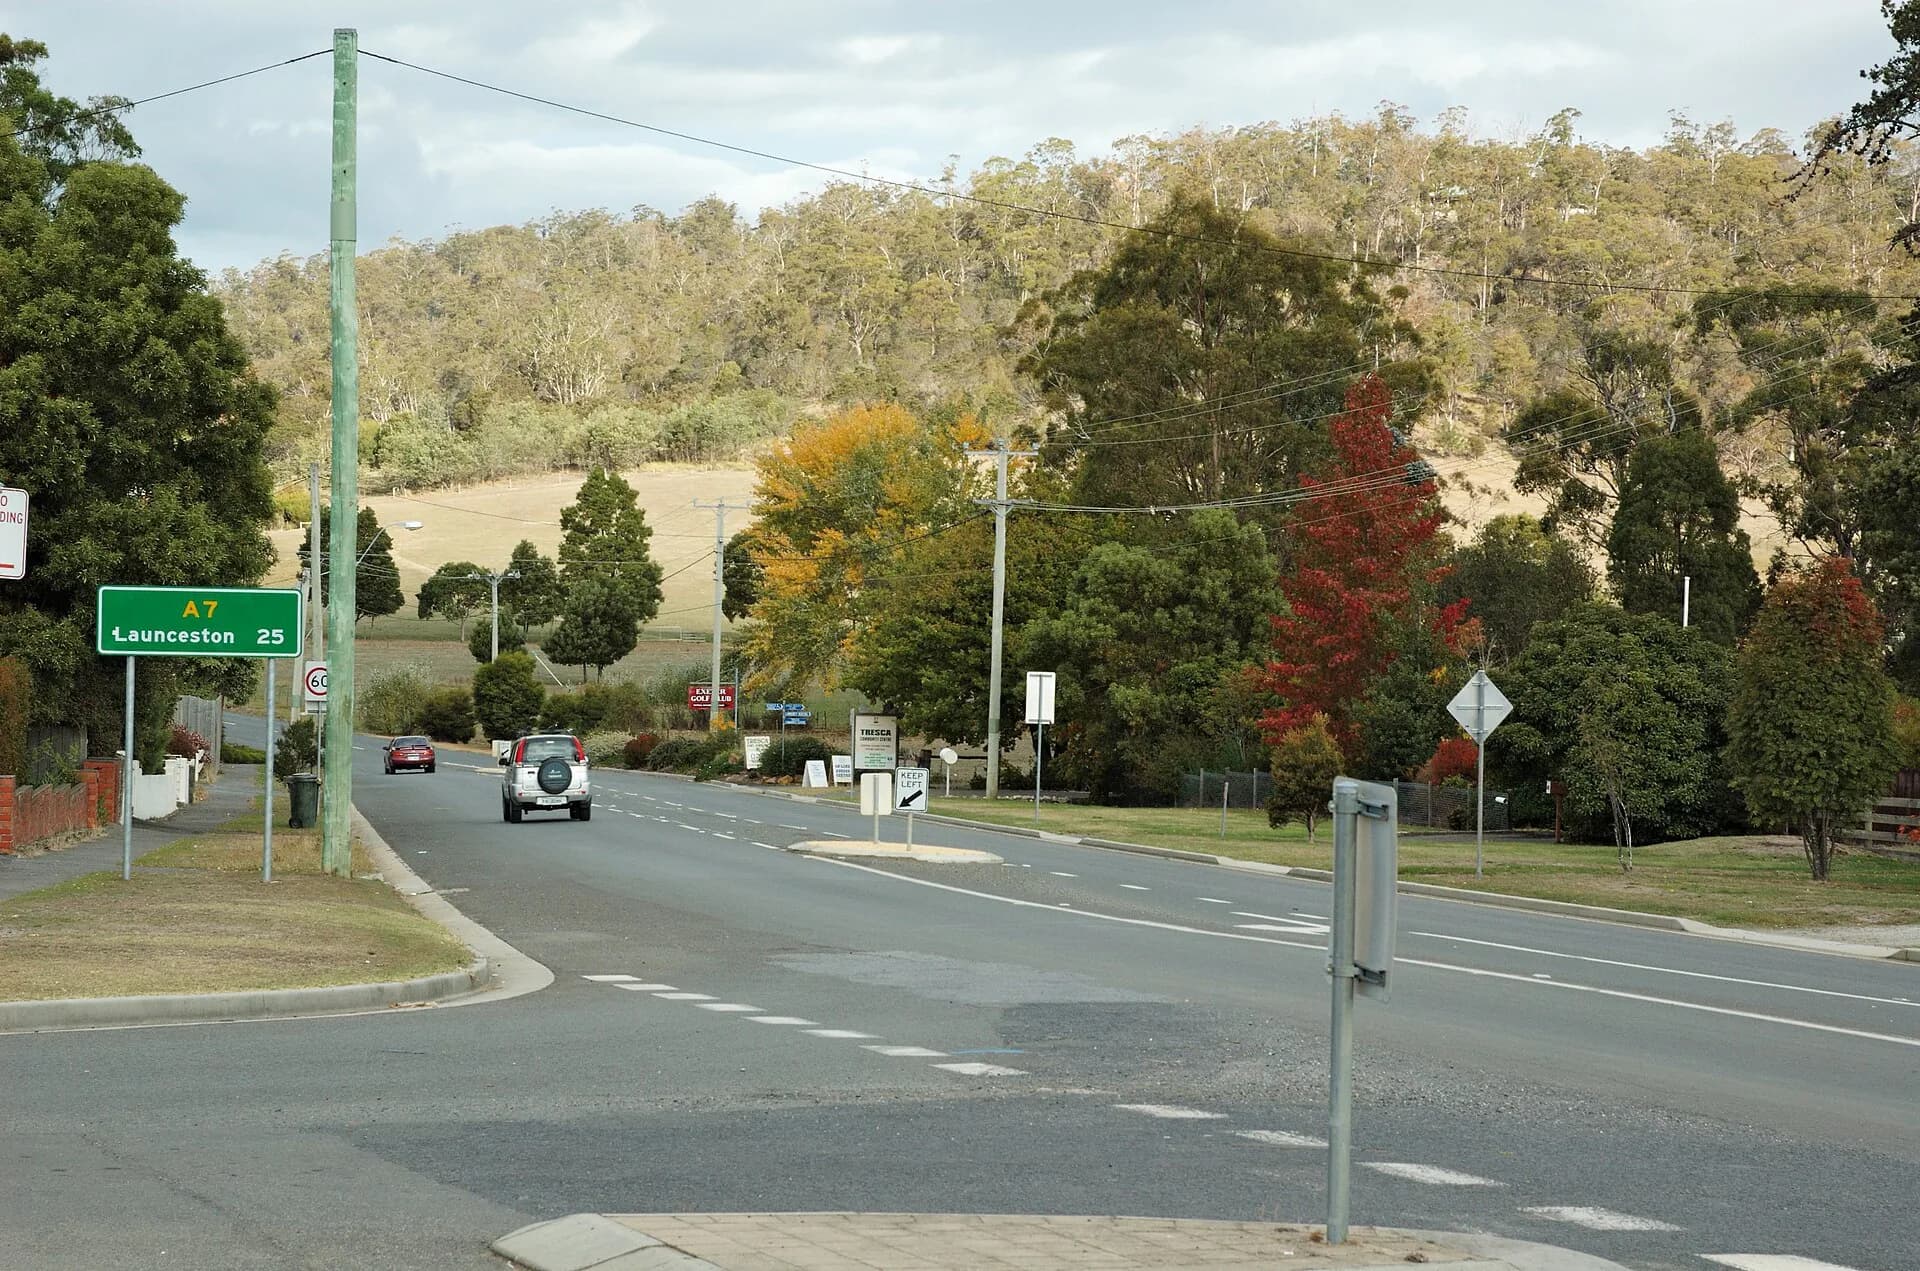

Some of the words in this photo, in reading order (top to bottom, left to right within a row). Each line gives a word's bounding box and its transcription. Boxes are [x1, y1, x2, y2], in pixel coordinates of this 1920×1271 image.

[182, 600, 218, 618] A7
[113, 627, 235, 644] Launceston
[257, 629, 284, 645] 25
[311, 675, 328, 688] 60
[901, 771, 923, 780] KEEP
[901, 780, 922, 788] LEFT
